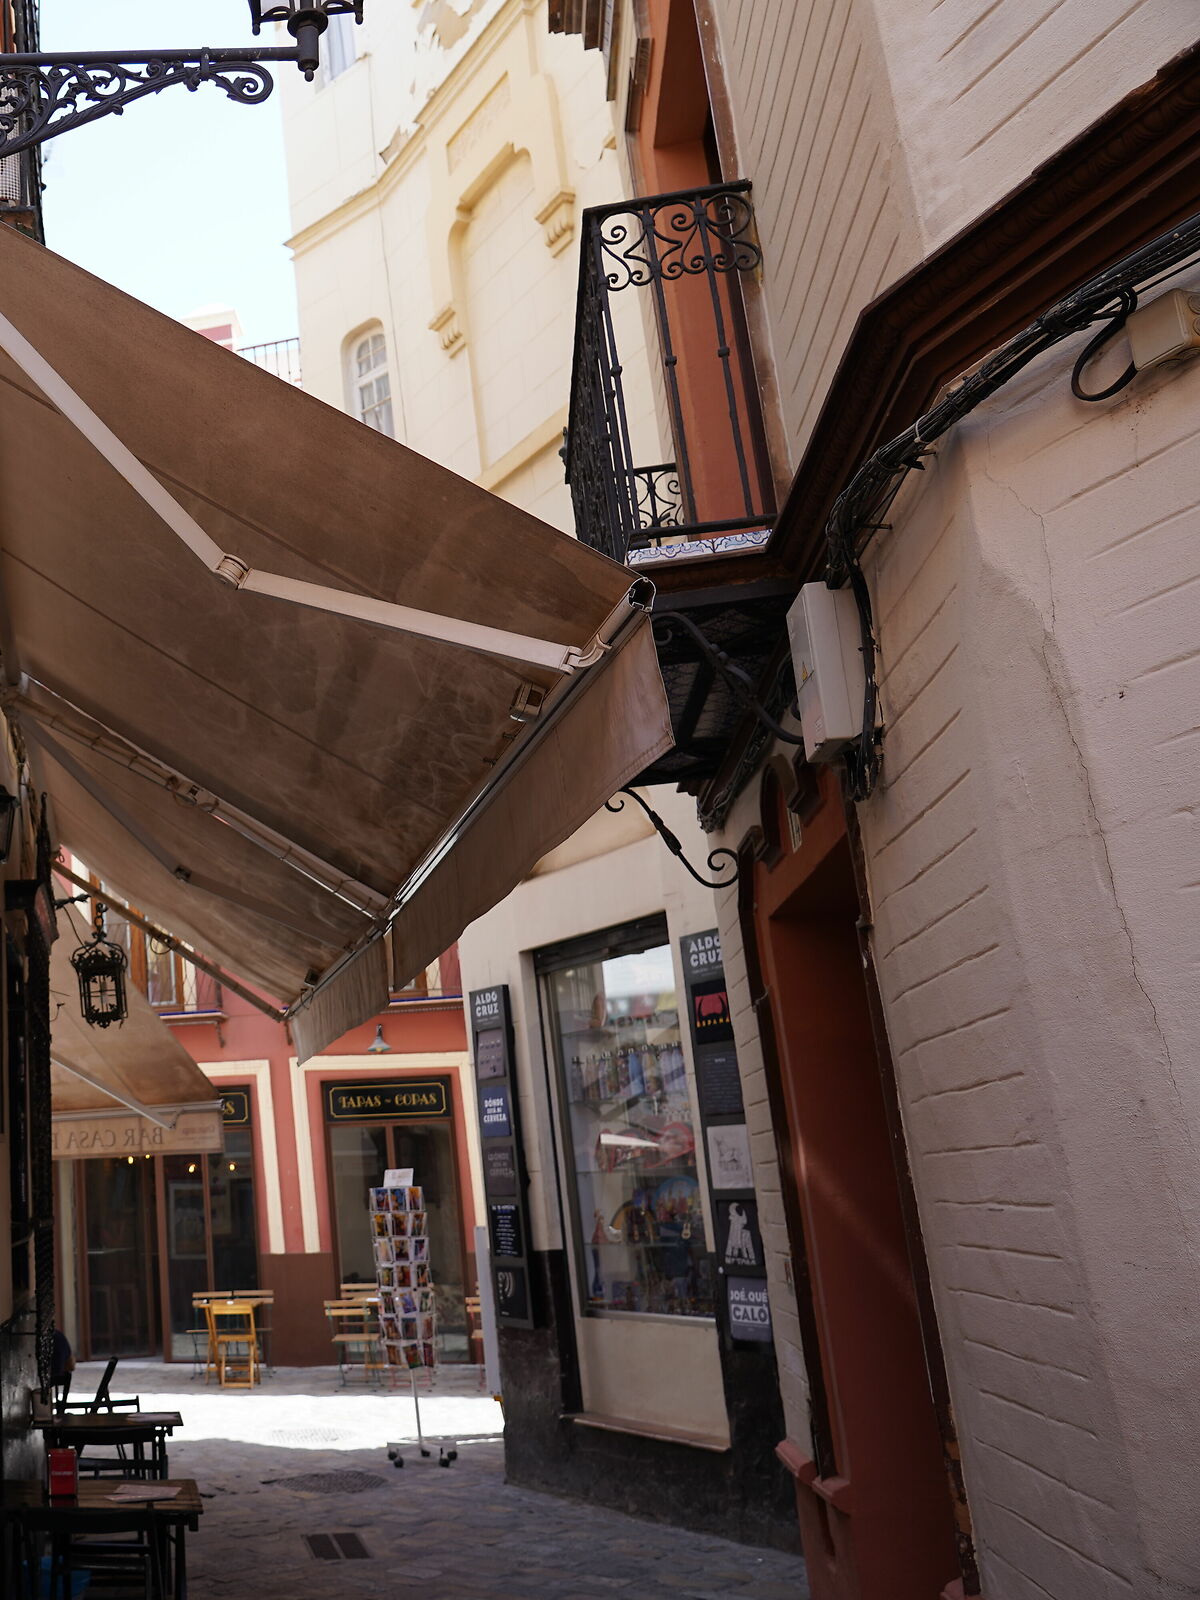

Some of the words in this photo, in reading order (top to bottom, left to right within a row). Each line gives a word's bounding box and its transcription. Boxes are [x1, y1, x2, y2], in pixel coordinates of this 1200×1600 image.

[690, 935, 721, 954] ALDO
[689, 948, 723, 968] CRUZ
[475, 991, 498, 1006] ALDO
[475, 1002, 499, 1018] CRUZ
[338, 1094, 382, 1109] TAPAS
[394, 1092, 437, 1107] COPAS
[732, 1304, 768, 1323] CALÓ
